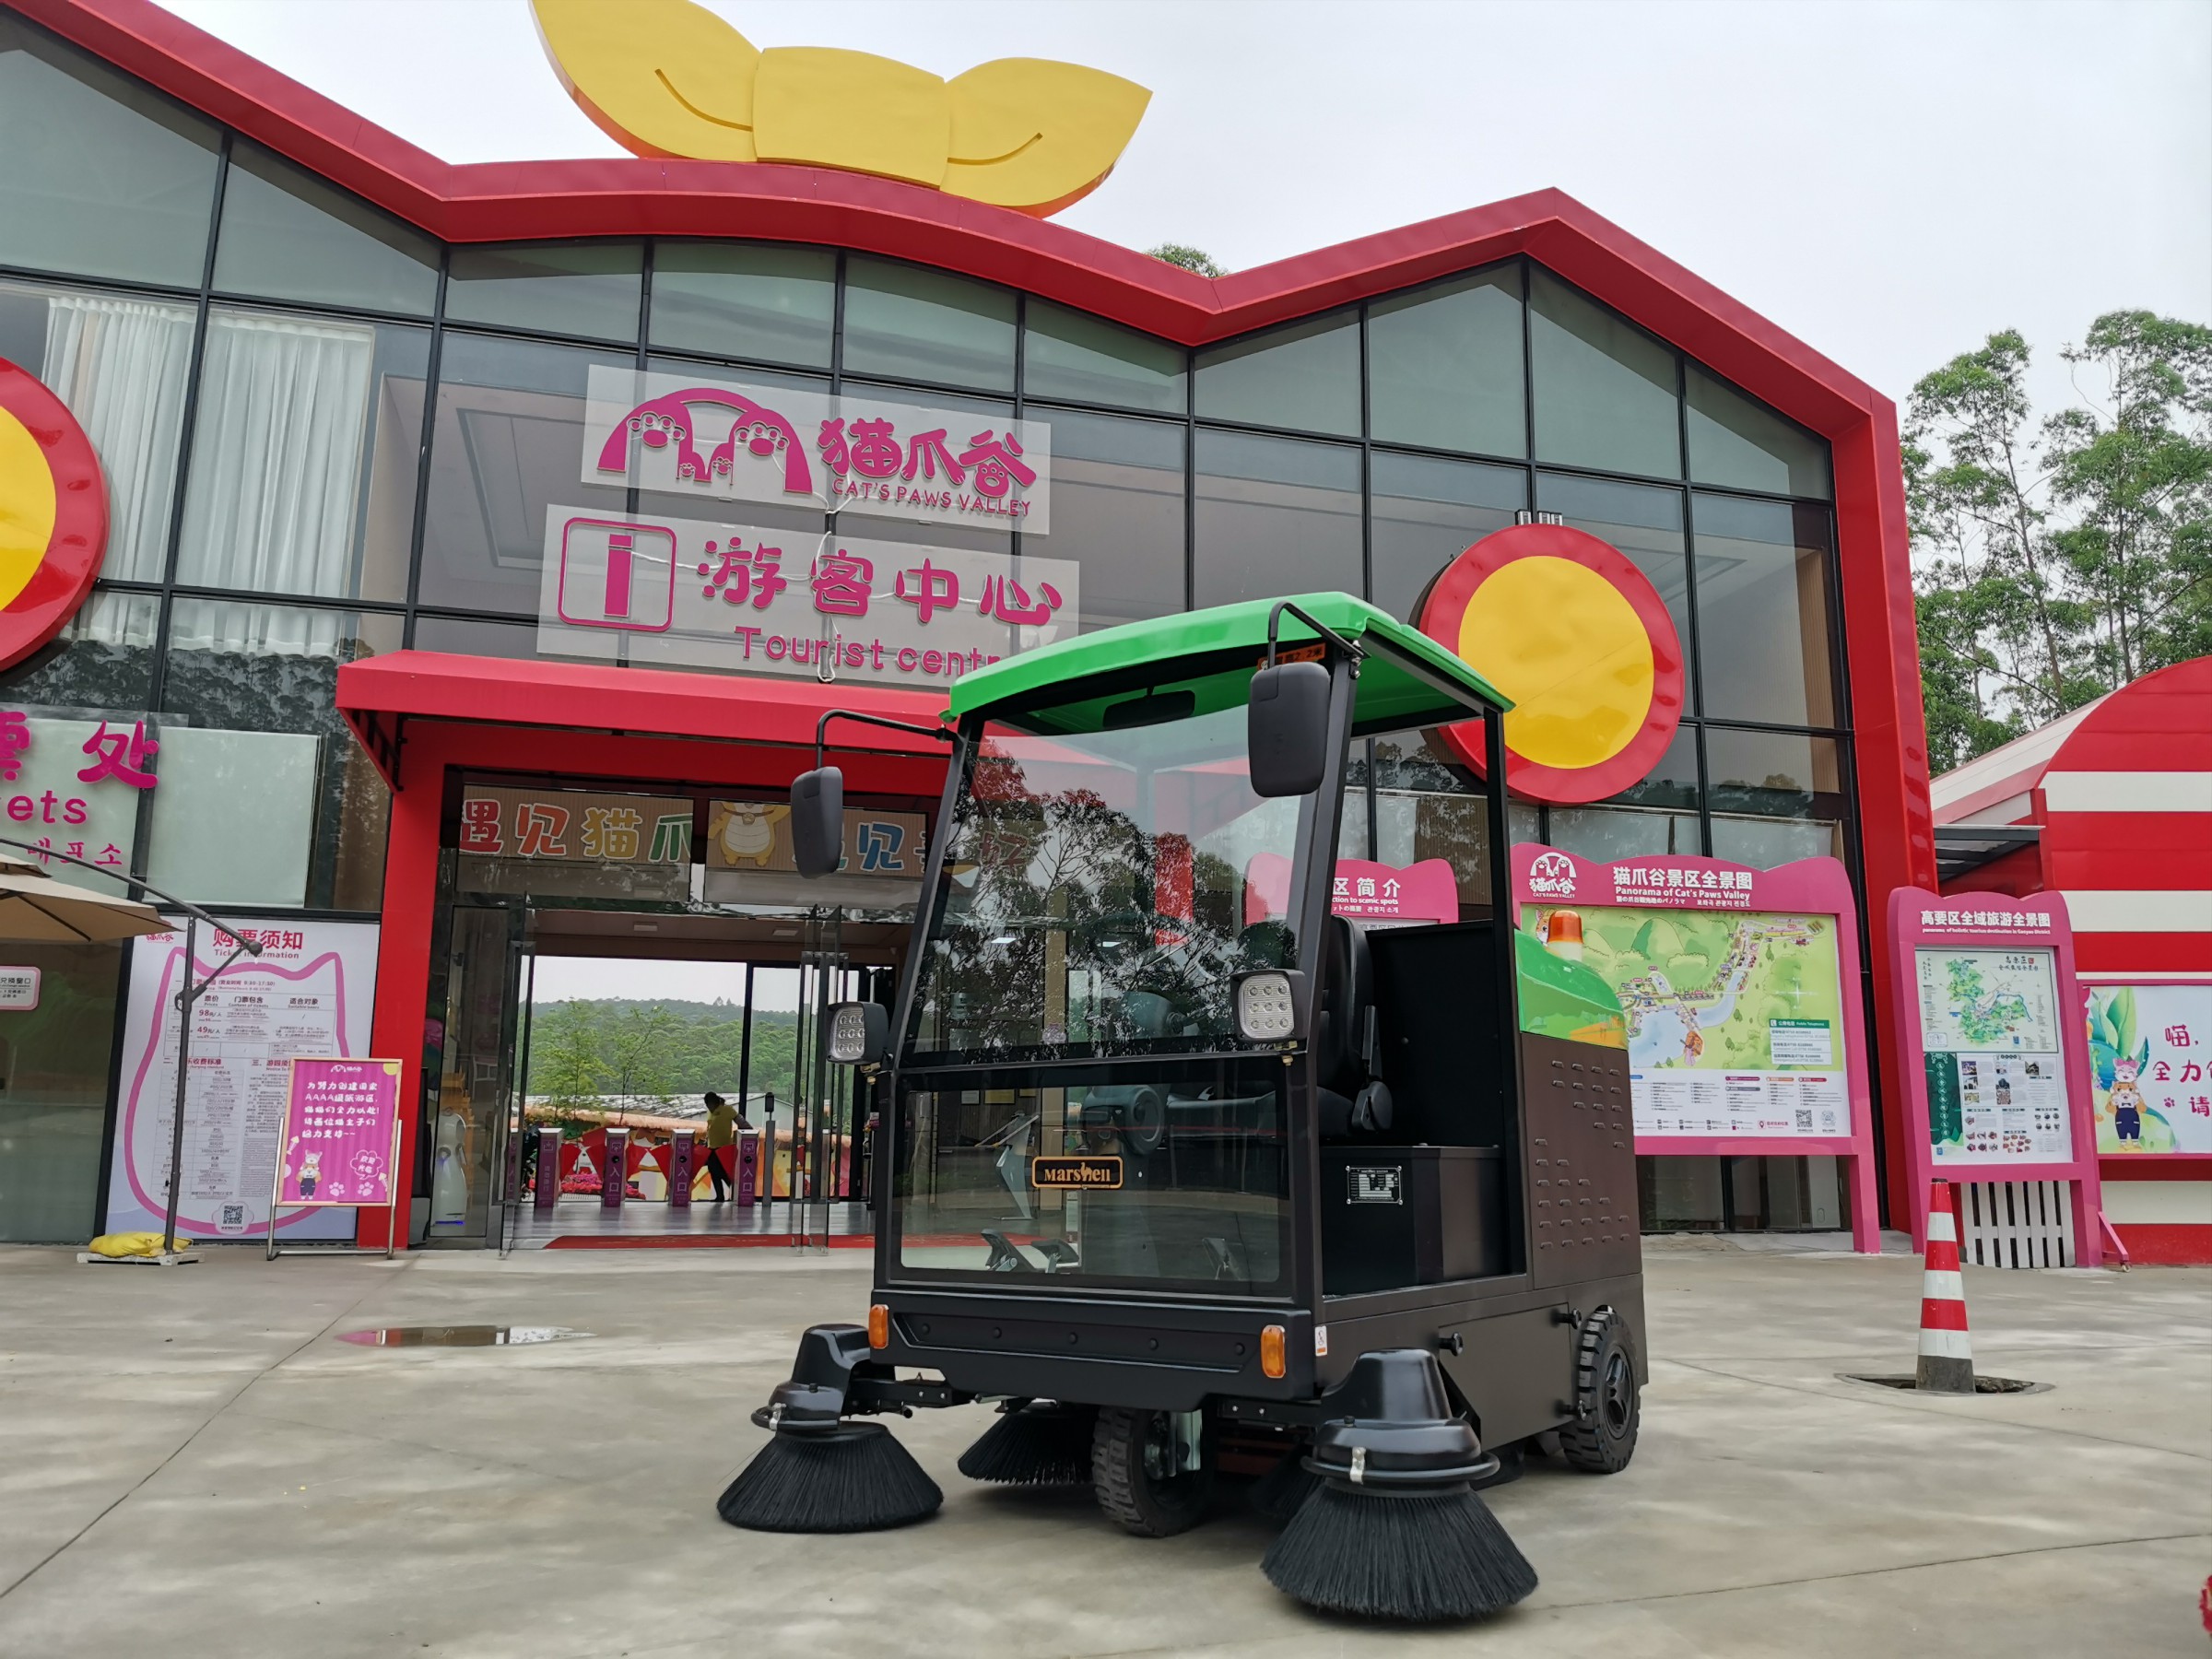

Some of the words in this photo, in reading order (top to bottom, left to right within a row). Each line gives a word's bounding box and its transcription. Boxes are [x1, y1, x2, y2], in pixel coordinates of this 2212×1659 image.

[818, 418, 1037, 499] 猫爪谷
[832, 477, 891, 501] CAT'S
[897, 486, 952, 508] PAWS
[959, 494, 1031, 516] VALLEY
[697, 536, 1064, 625] 游客中心
[735, 627, 885, 670] Tourist
[898, 645, 1001, 676] centr
[0, 790, 88, 824] ets
[1613, 866, 1753, 890] 猫爪谷景区全景图
[1616, 887, 1662, 896] Panorama
[1663, 888, 1673, 897] of
[1675, 889, 1698, 899] Cat's
[1699, 890, 1722, 900] Paws
[1724, 891, 1750, 901] Valley
[1920, 910, 2052, 927] 高要区全域旅游全景图
[2152, 1059, 2212, 1083] 全力
[2188, 1096, 2210, 1118] 请
[609, 1166, 620, 1193] 入口
[677, 1166, 688, 1193] 入口
[742, 1167, 754, 1193] 入口
